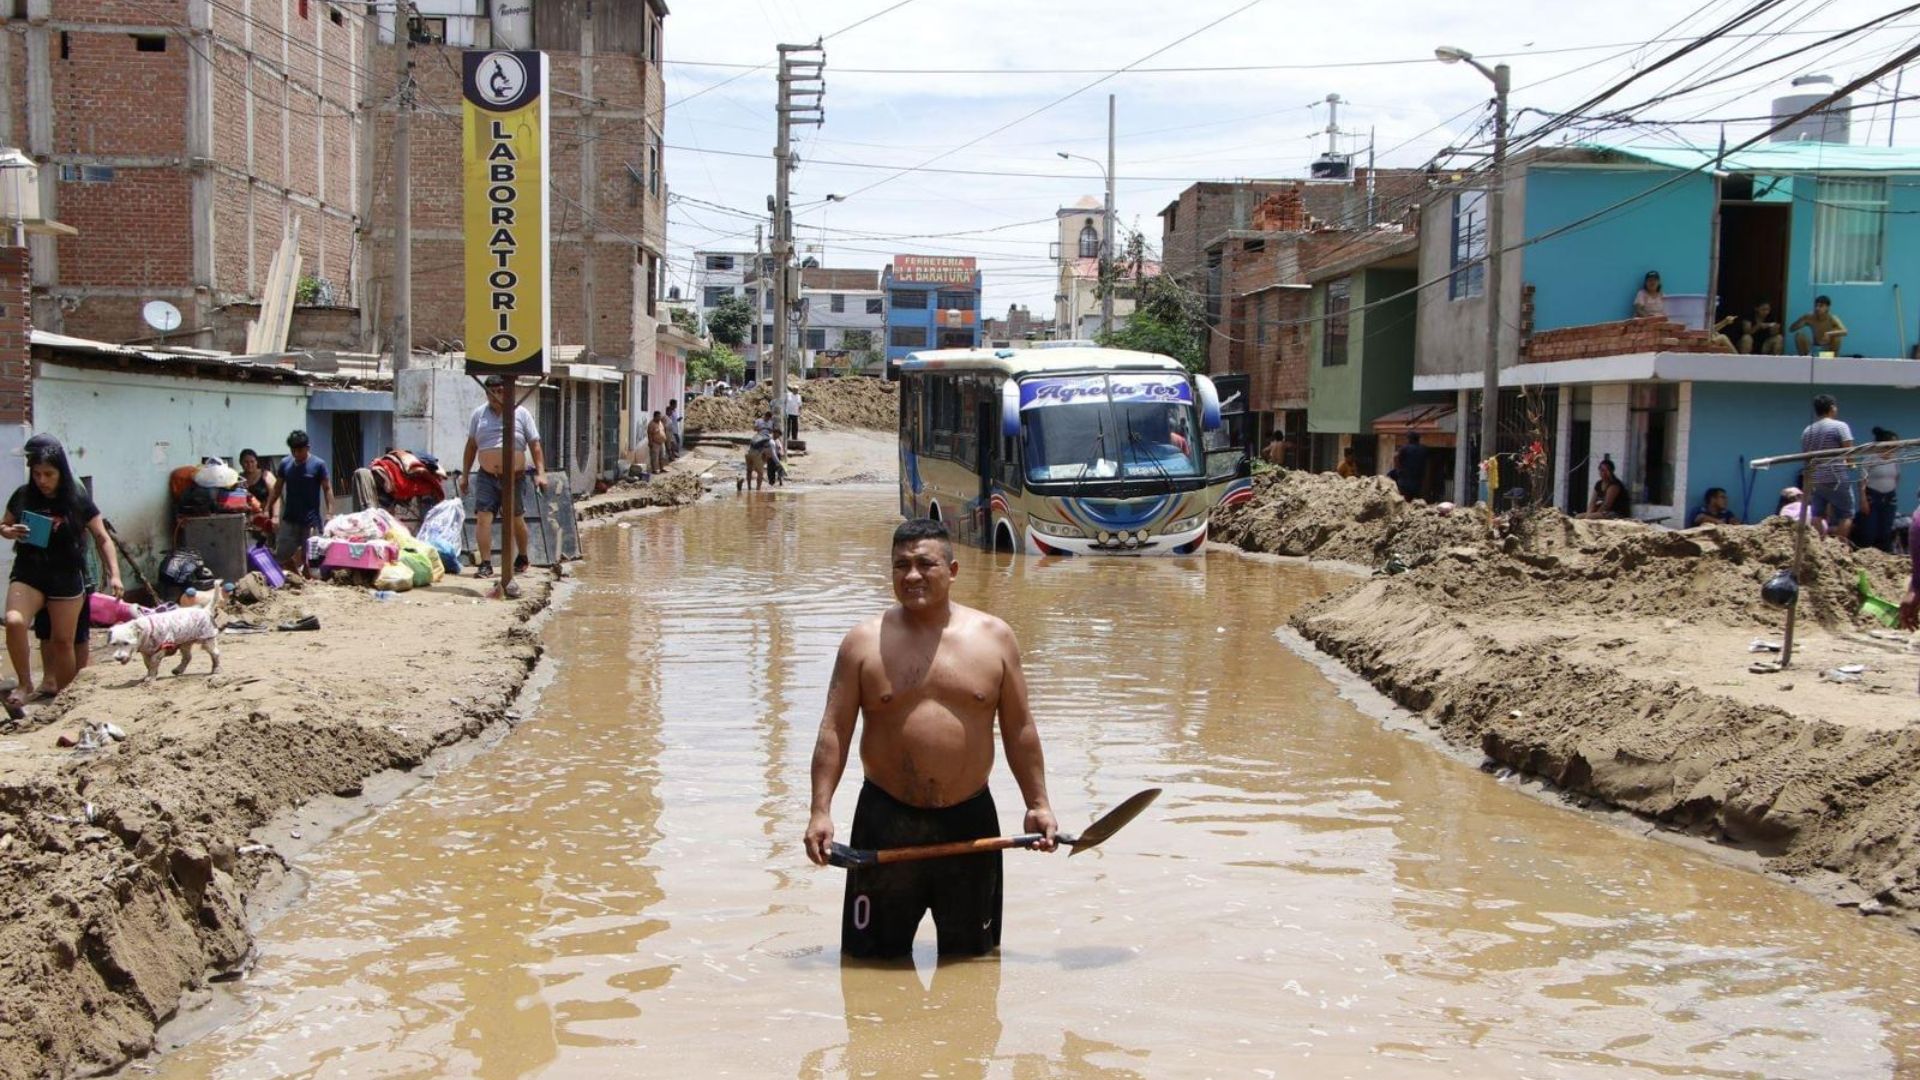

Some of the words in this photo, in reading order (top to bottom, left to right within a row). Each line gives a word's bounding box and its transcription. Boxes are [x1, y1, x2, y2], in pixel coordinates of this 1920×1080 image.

[488, 121, 517, 352] LABORATORIO
[905, 257, 965, 266] FERRETERIA
[854, 895, 870, 930] 0
